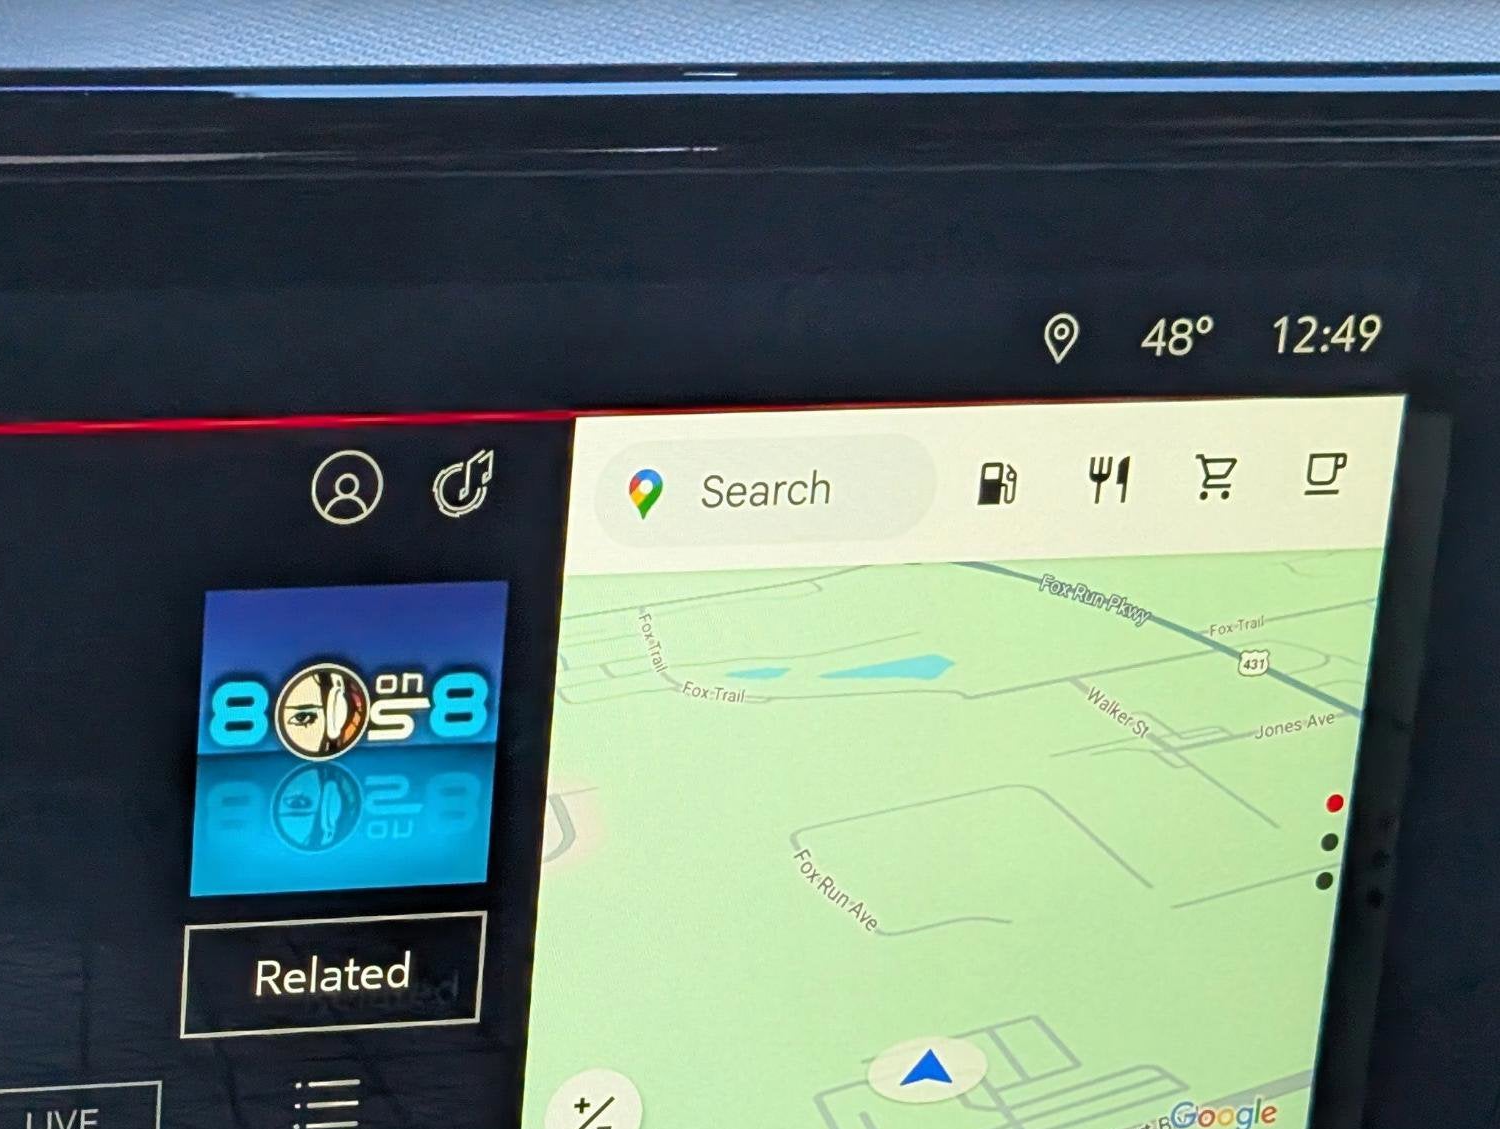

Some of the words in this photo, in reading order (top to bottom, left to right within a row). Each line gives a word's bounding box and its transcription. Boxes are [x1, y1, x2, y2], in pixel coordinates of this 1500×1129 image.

[1273, 314, 1382, 354] 12:49
[701, 469, 831, 509] Search
[1037, 574, 1073, 599] Fox
[1071, 583, 1106, 609] Run
[1105, 594, 1151, 627] Pkwy
[639, 613, 654, 641] Fox
[648, 641, 669, 673] Trail
[1209, 621, 1234, 636] Fox
[1237, 615, 1264, 631] Trail
[1243, 657, 1264, 670] 431
[682, 680, 709, 699] Fox
[714, 687, 746, 704] Trail
[1086, 687, 1133, 727] Walker
[1132, 719, 1150, 739] St
[1255, 721, 1302, 740] Jones
[1307, 713, 1336, 728] Ave
[793, 848, 821, 884] Fox
[817, 875, 850, 908] Run
[848, 901, 878, 932] Ave
[255, 950, 411, 997] Related
